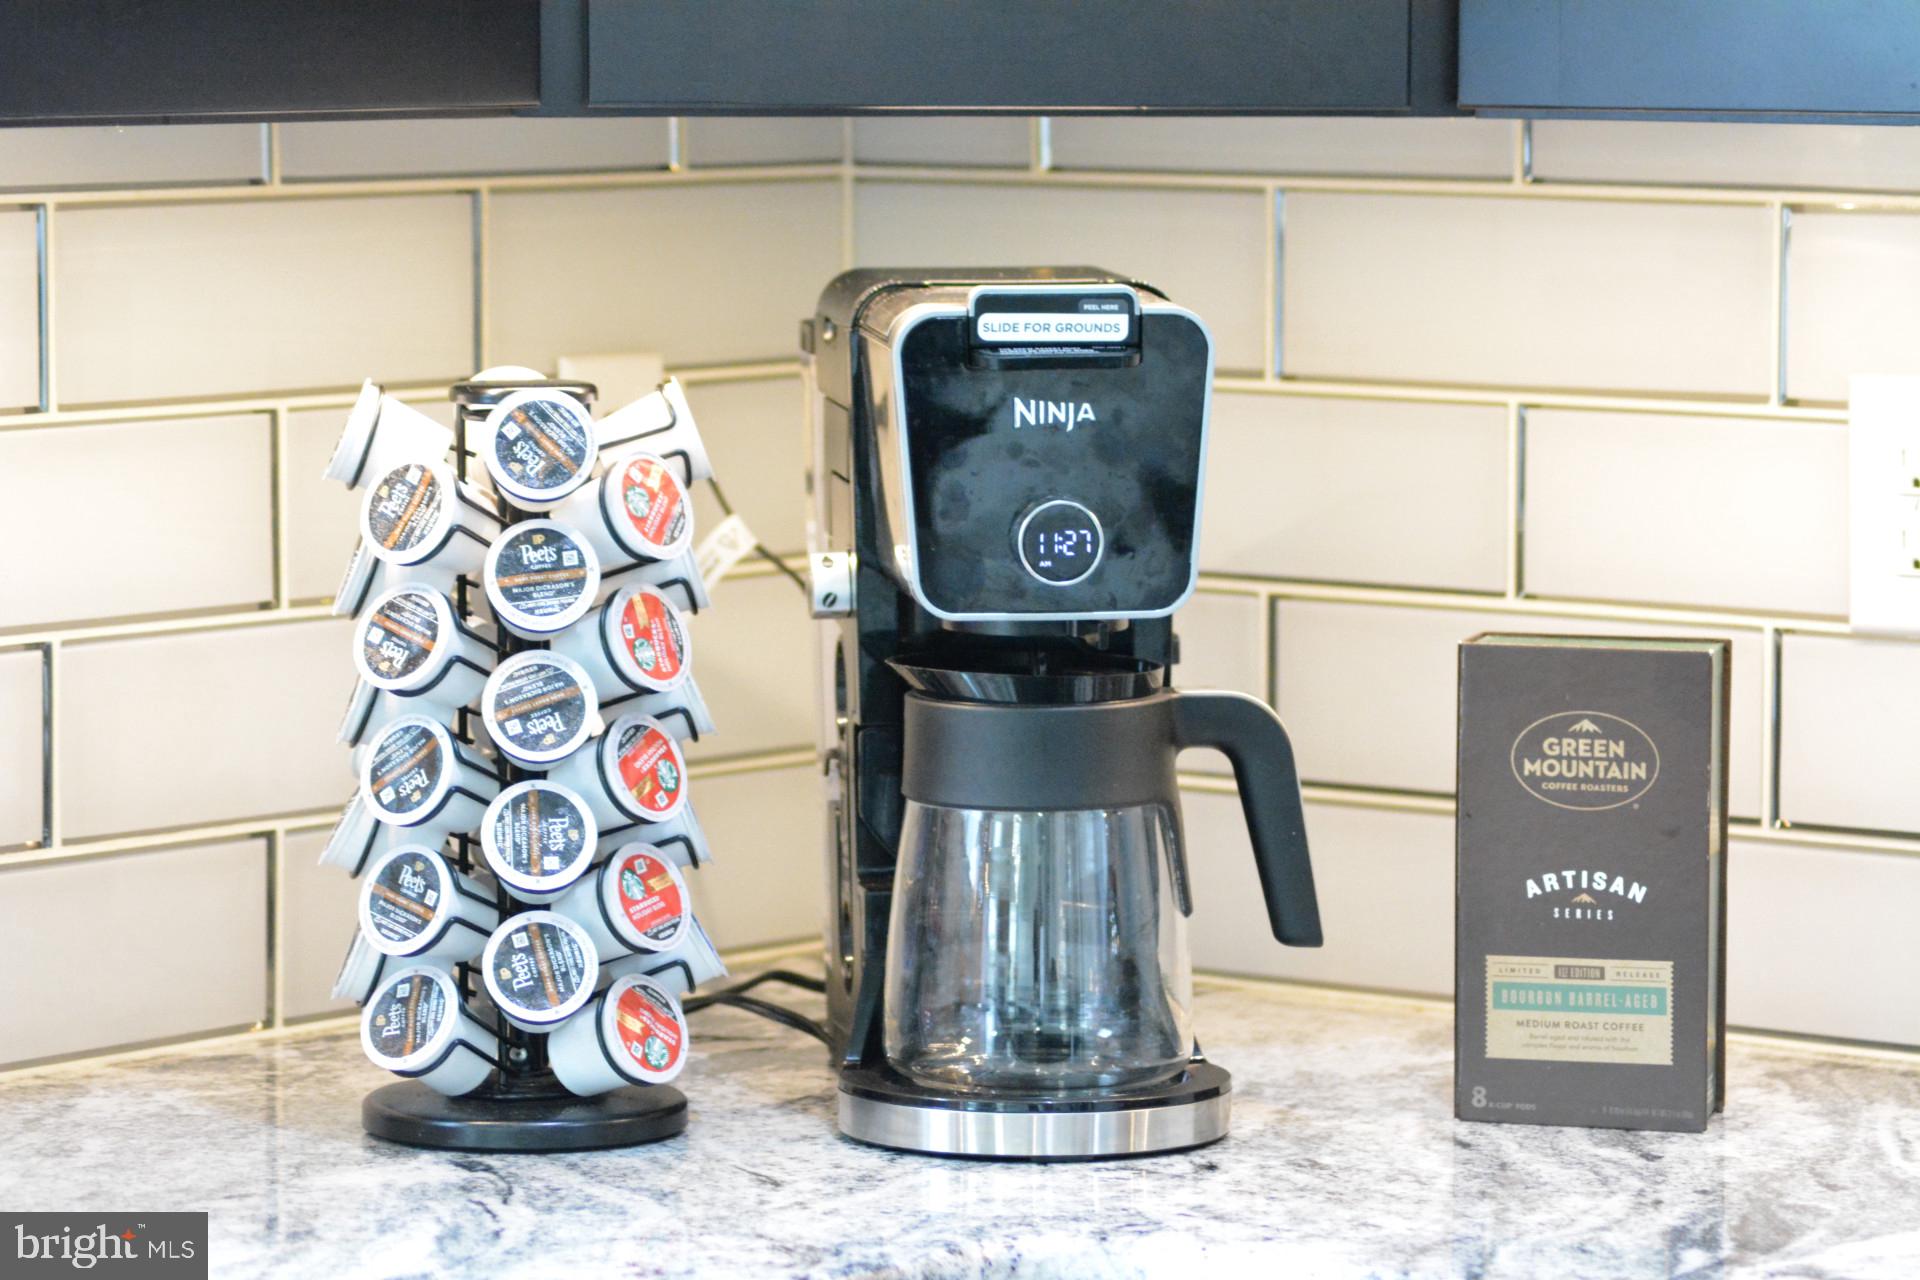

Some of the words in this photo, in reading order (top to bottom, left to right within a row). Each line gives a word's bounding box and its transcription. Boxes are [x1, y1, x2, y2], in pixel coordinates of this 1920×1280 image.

[983, 322, 1020, 333] SLIDE
[1024, 322, 1051, 333] FOR
[1055, 322, 1121, 333] GROUNDS
[1013, 396, 1096, 432] NINJA
[518, 542, 557, 564] Peet's
[1039, 529, 1092, 556] 11:27
[525, 710, 566, 735] Peet's
[1542, 737, 1625, 758] GREEN
[1523, 758, 1647, 780] MOUNTAIN
[1541, 782, 1578, 791] COFFEE
[1580, 783, 1629, 793] ROASTERS
[548, 815, 568, 851] Peet's
[395, 864, 428, 893] Peet's
[1526, 870, 1647, 903] ARTISAN
[1553, 907, 1613, 920] SERIES
[511, 952, 534, 991] Peet's
[1502, 989, 1562, 1006] BOURBON
[381, 1001, 402, 1040] Peet's
[1516, 1019, 1561, 1029] MEDIUM
[1564, 1021, 1599, 1030] ROAST
[1602, 1022, 1645, 1032] COFFEE
[1471, 1086, 1487, 1108] 8
